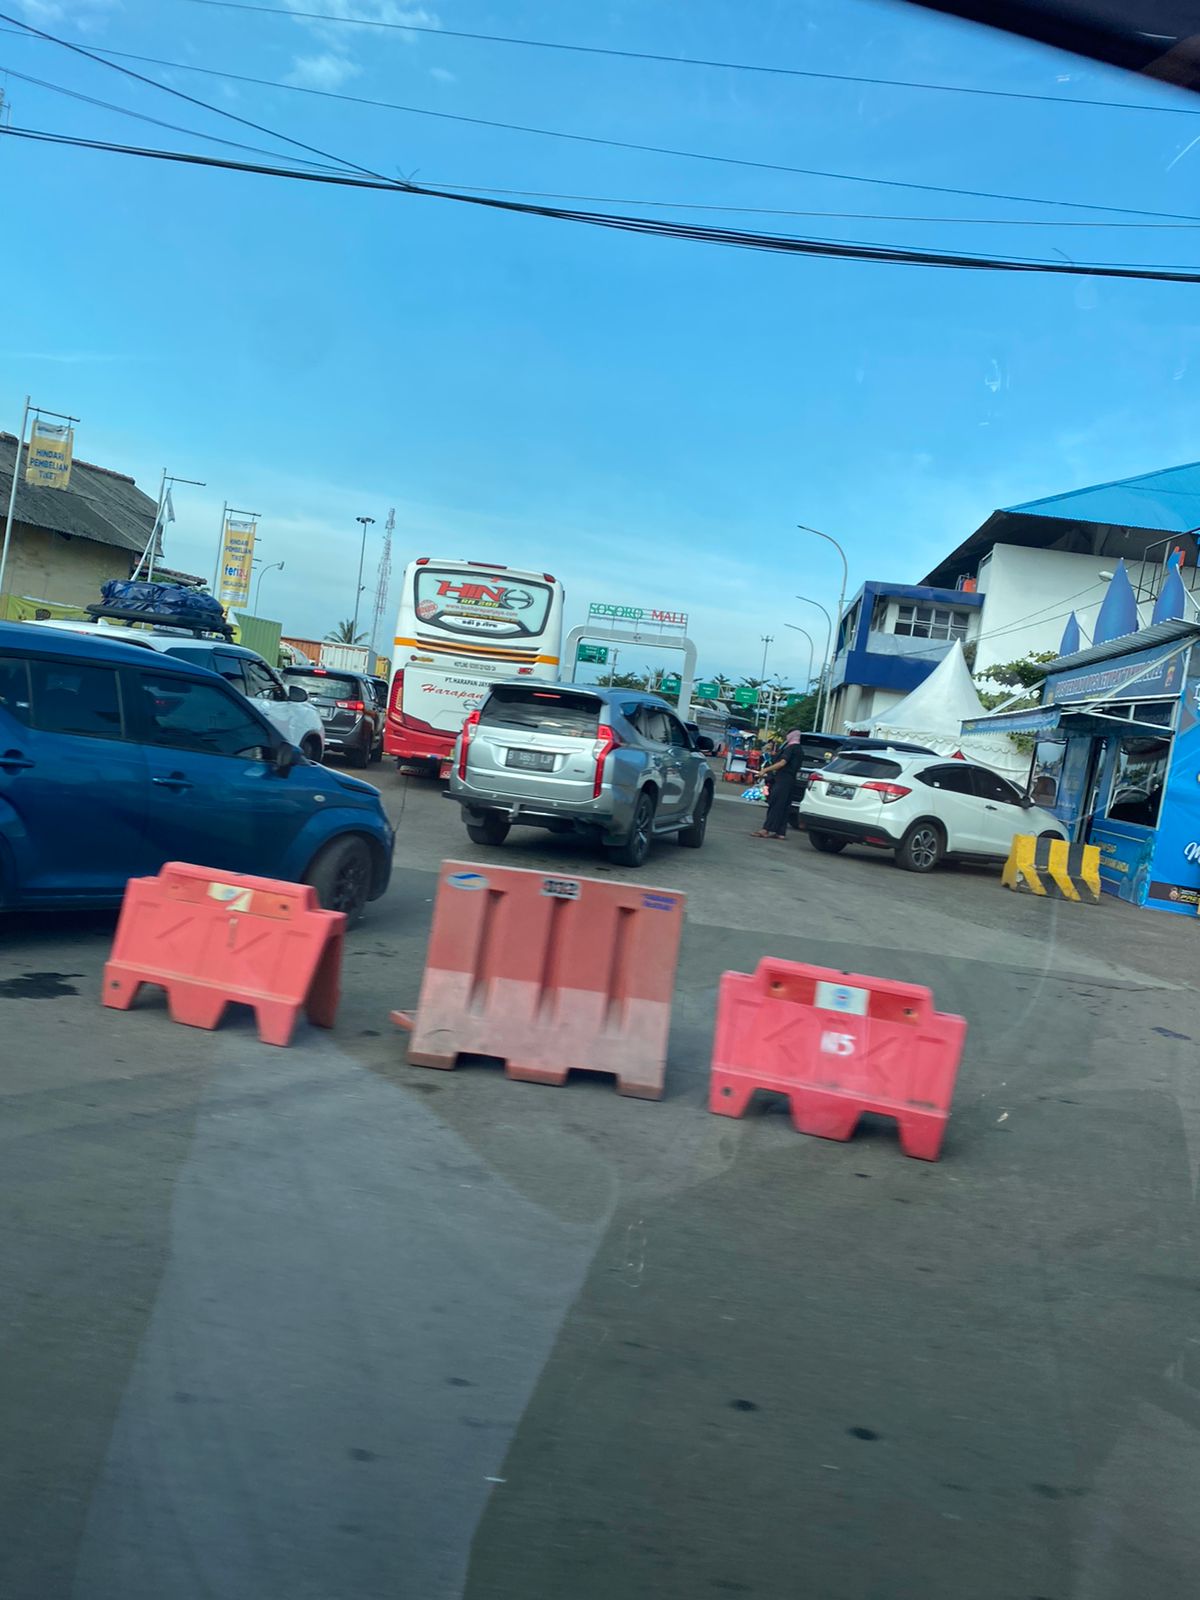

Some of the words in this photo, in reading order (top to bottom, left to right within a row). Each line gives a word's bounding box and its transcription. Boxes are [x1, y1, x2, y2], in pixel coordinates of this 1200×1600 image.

[590, 603, 643, 619] SOSORO
[651, 609, 685, 624] MALL
[421, 683, 484, 699] Harapan
